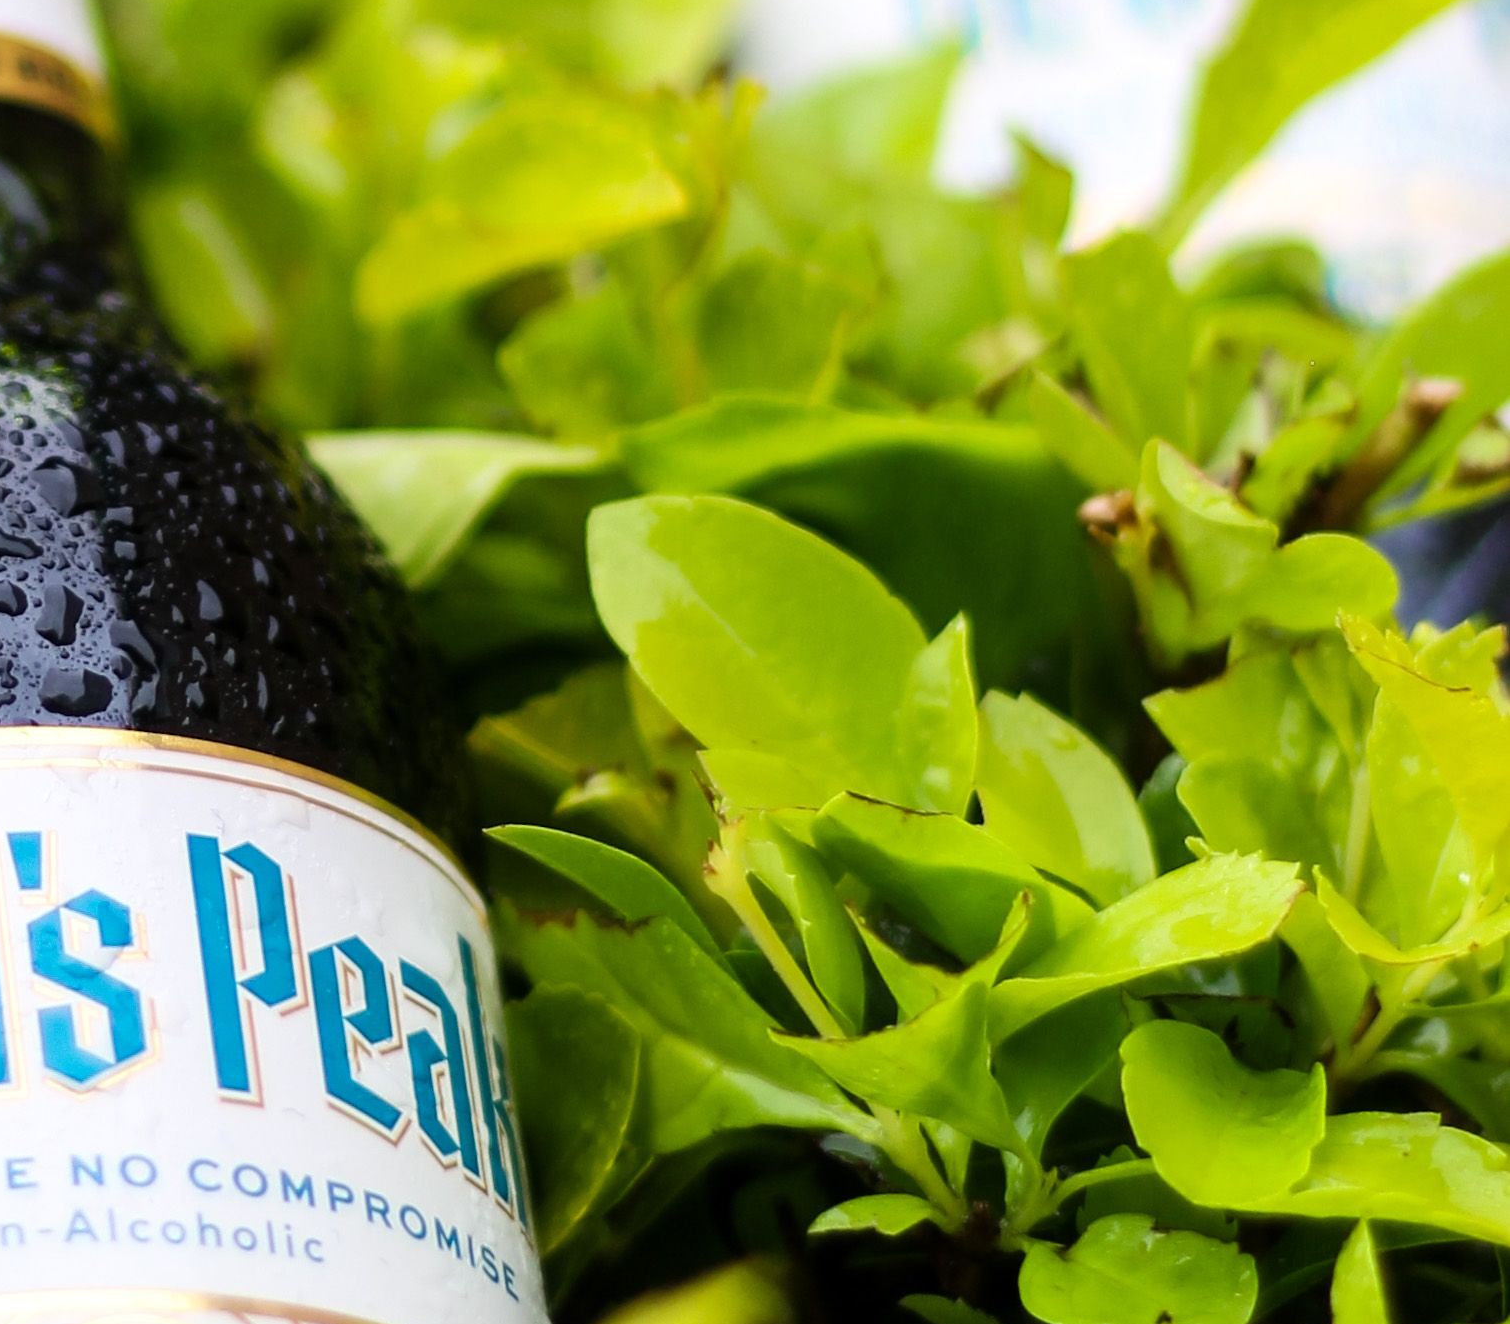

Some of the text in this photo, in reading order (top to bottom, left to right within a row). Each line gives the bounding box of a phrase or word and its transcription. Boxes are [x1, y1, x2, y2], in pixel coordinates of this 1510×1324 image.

[185, 831, 534, 1231] Peak
[70, 1154, 158, 1187] NO
[189, 1158, 519, 1303] COMPROMISE
